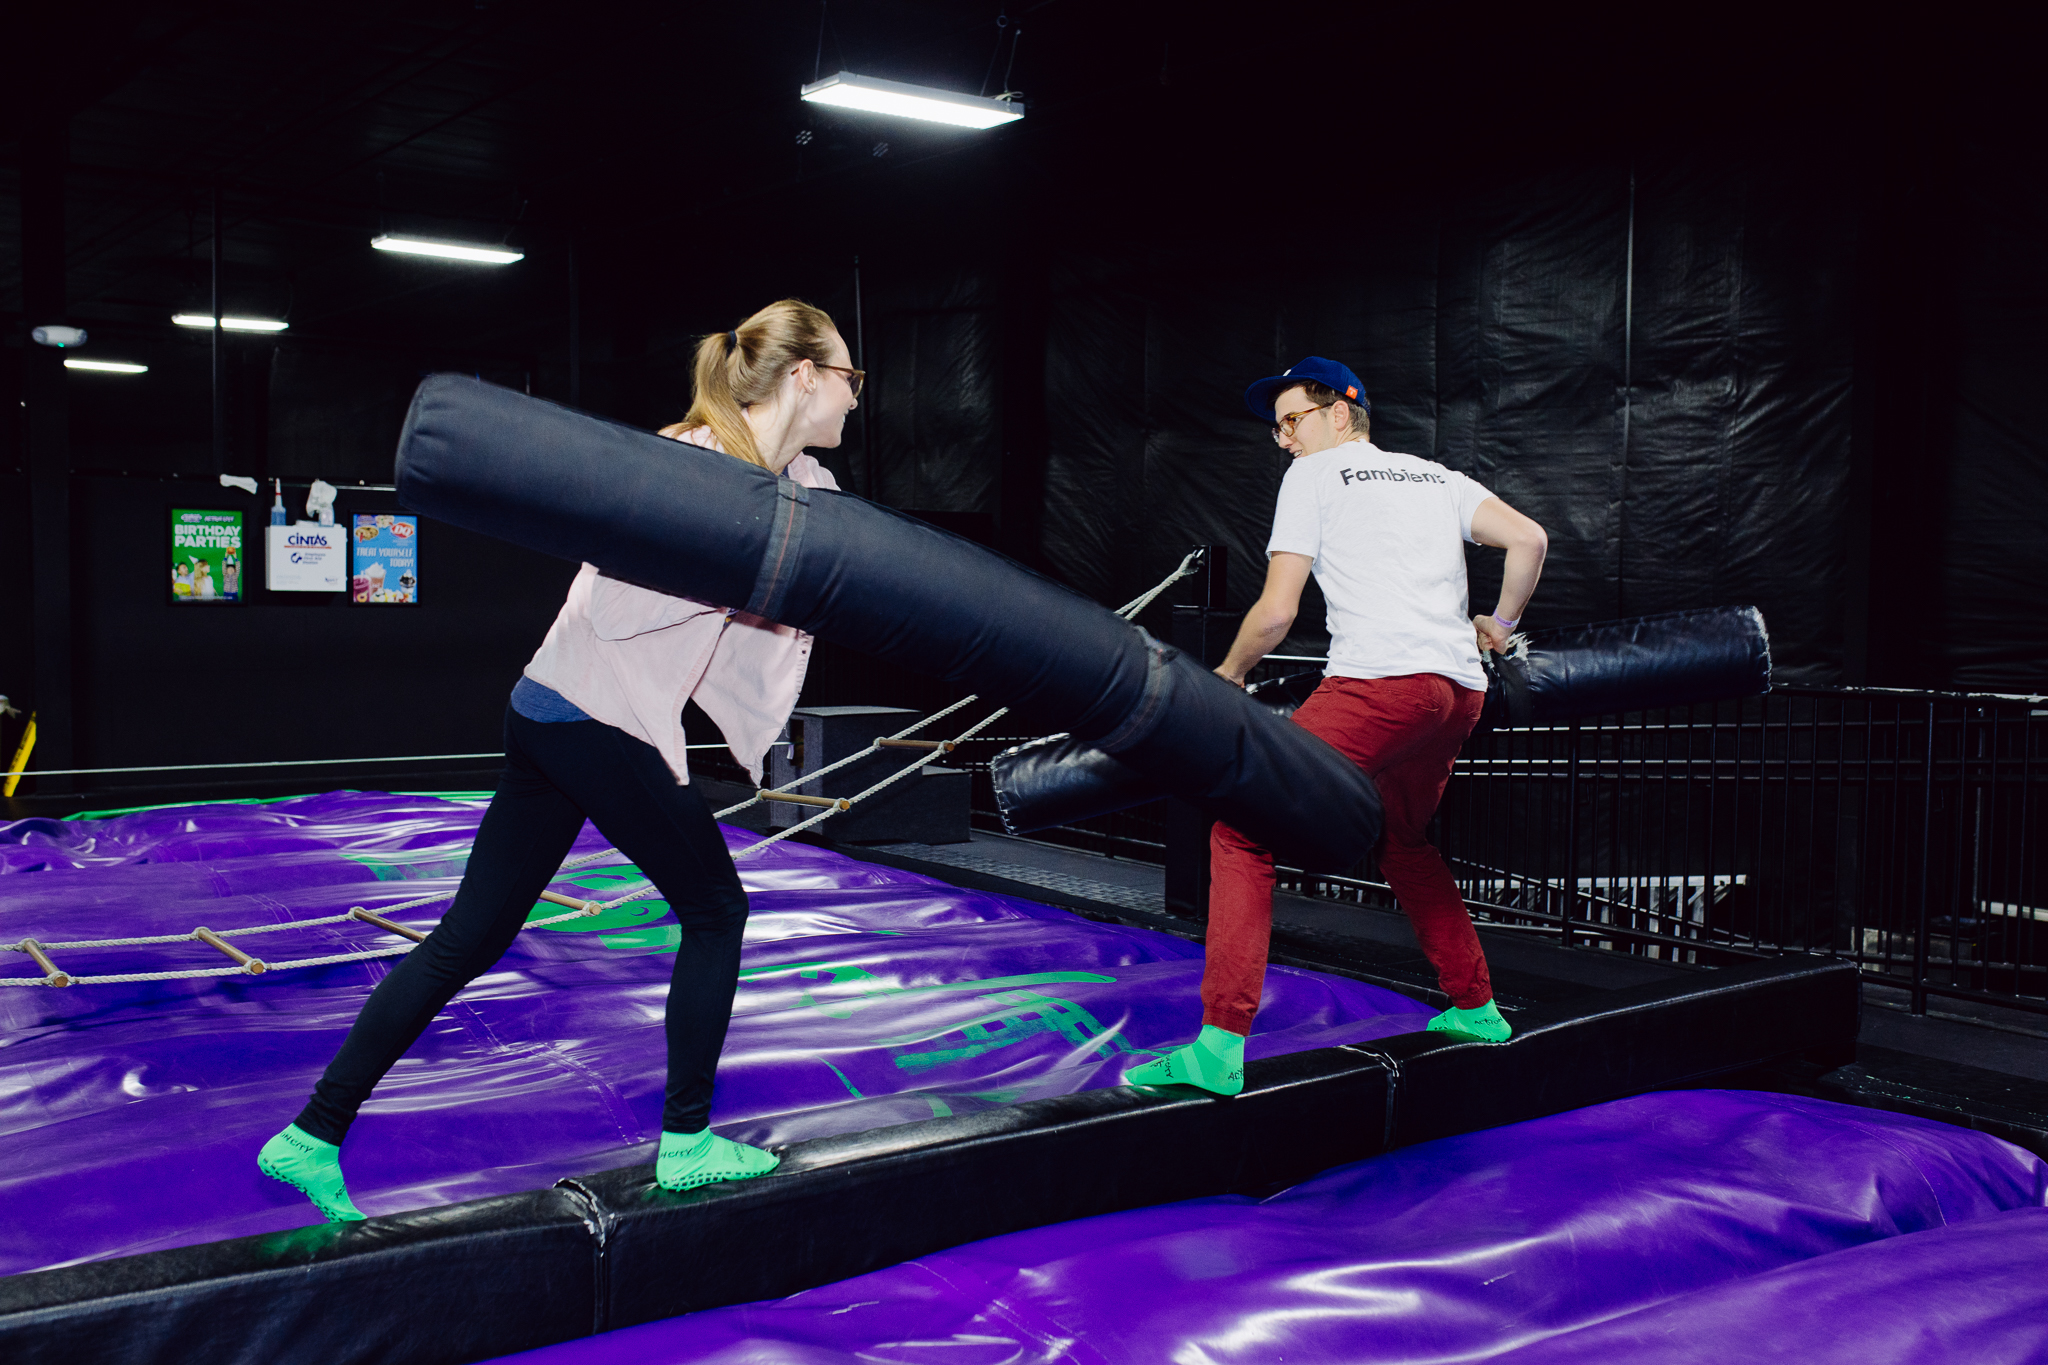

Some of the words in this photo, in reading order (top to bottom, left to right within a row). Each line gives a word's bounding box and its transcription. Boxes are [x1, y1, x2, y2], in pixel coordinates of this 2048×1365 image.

[175, 524, 241, 536] BIRTHDAY
[393, 525, 411, 537] DQ
[175, 535, 241, 548] PARTIES
[356, 547, 377, 557] TREAT
[379, 547, 413, 557] YOURSELF
[390, 558, 414, 567] TODAY!
